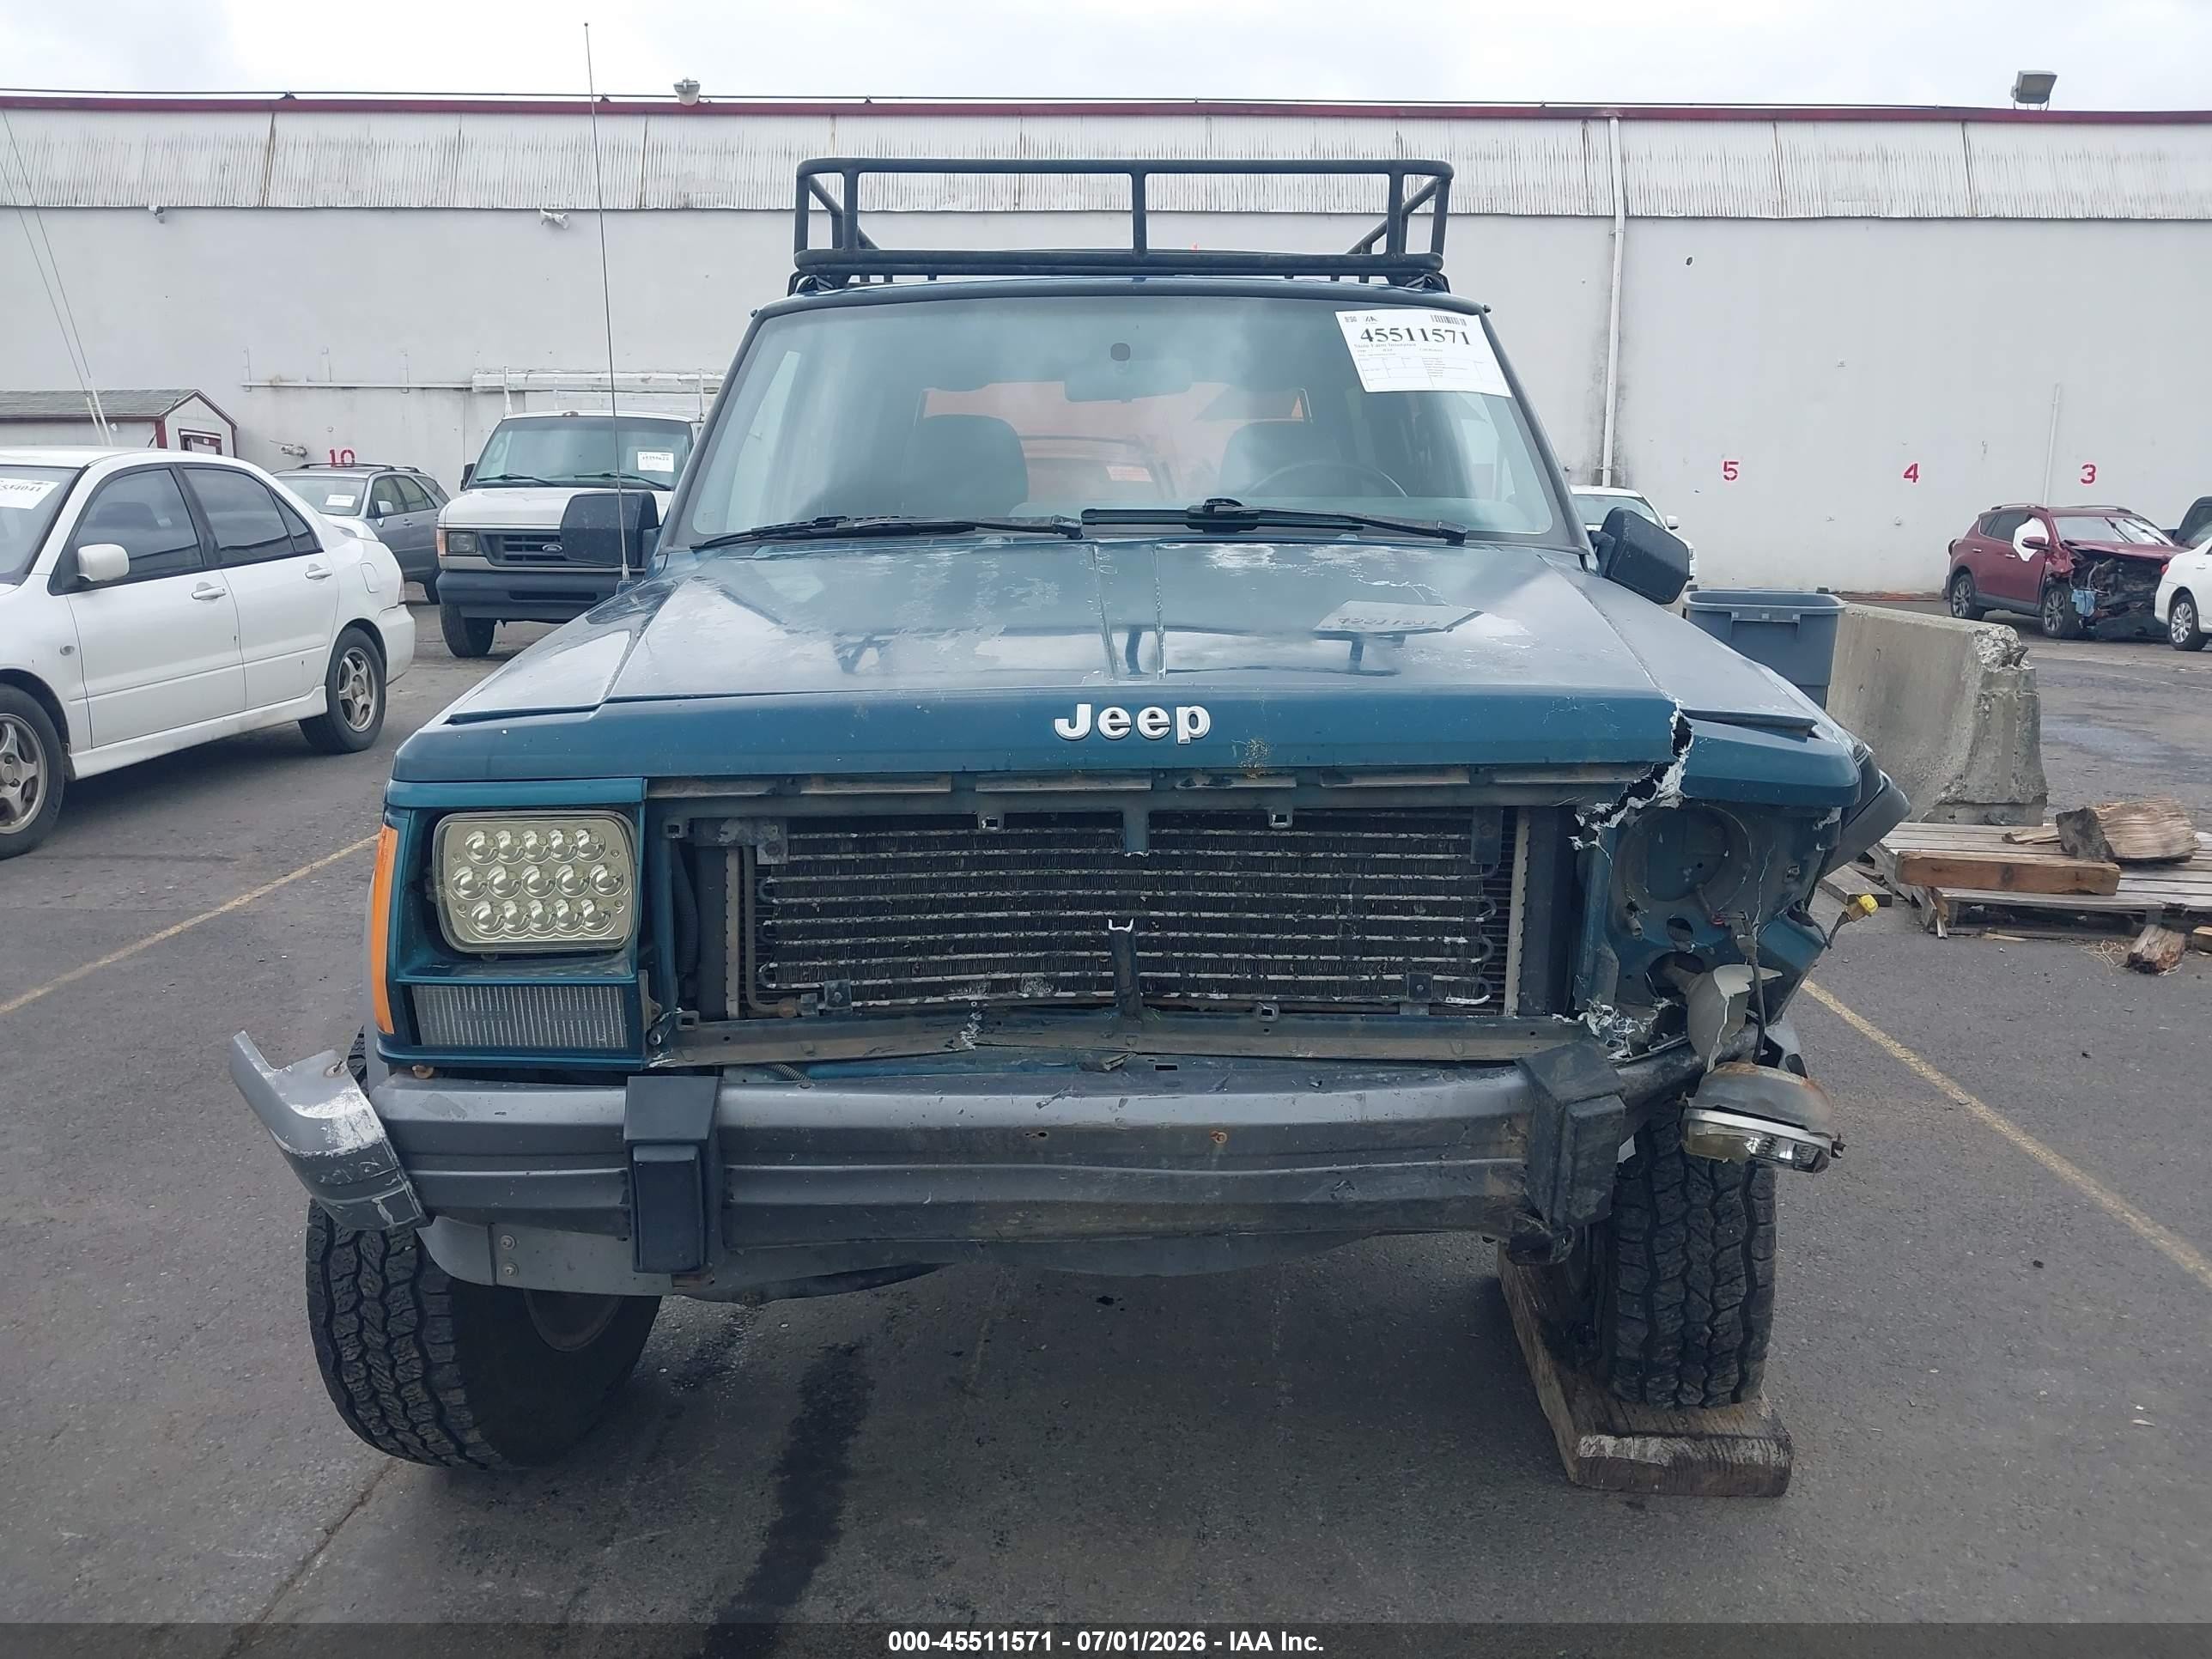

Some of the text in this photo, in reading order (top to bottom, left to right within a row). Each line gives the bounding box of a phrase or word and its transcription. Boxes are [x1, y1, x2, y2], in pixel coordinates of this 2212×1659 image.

[1360, 327, 1471, 345] 45511571
[330, 449, 355, 468] 10
[1723, 461, 1739, 481] 5
[1904, 463, 1919, 483] 4
[2081, 464, 2096, 483] 3
[1054, 703, 1211, 744] Jeep
